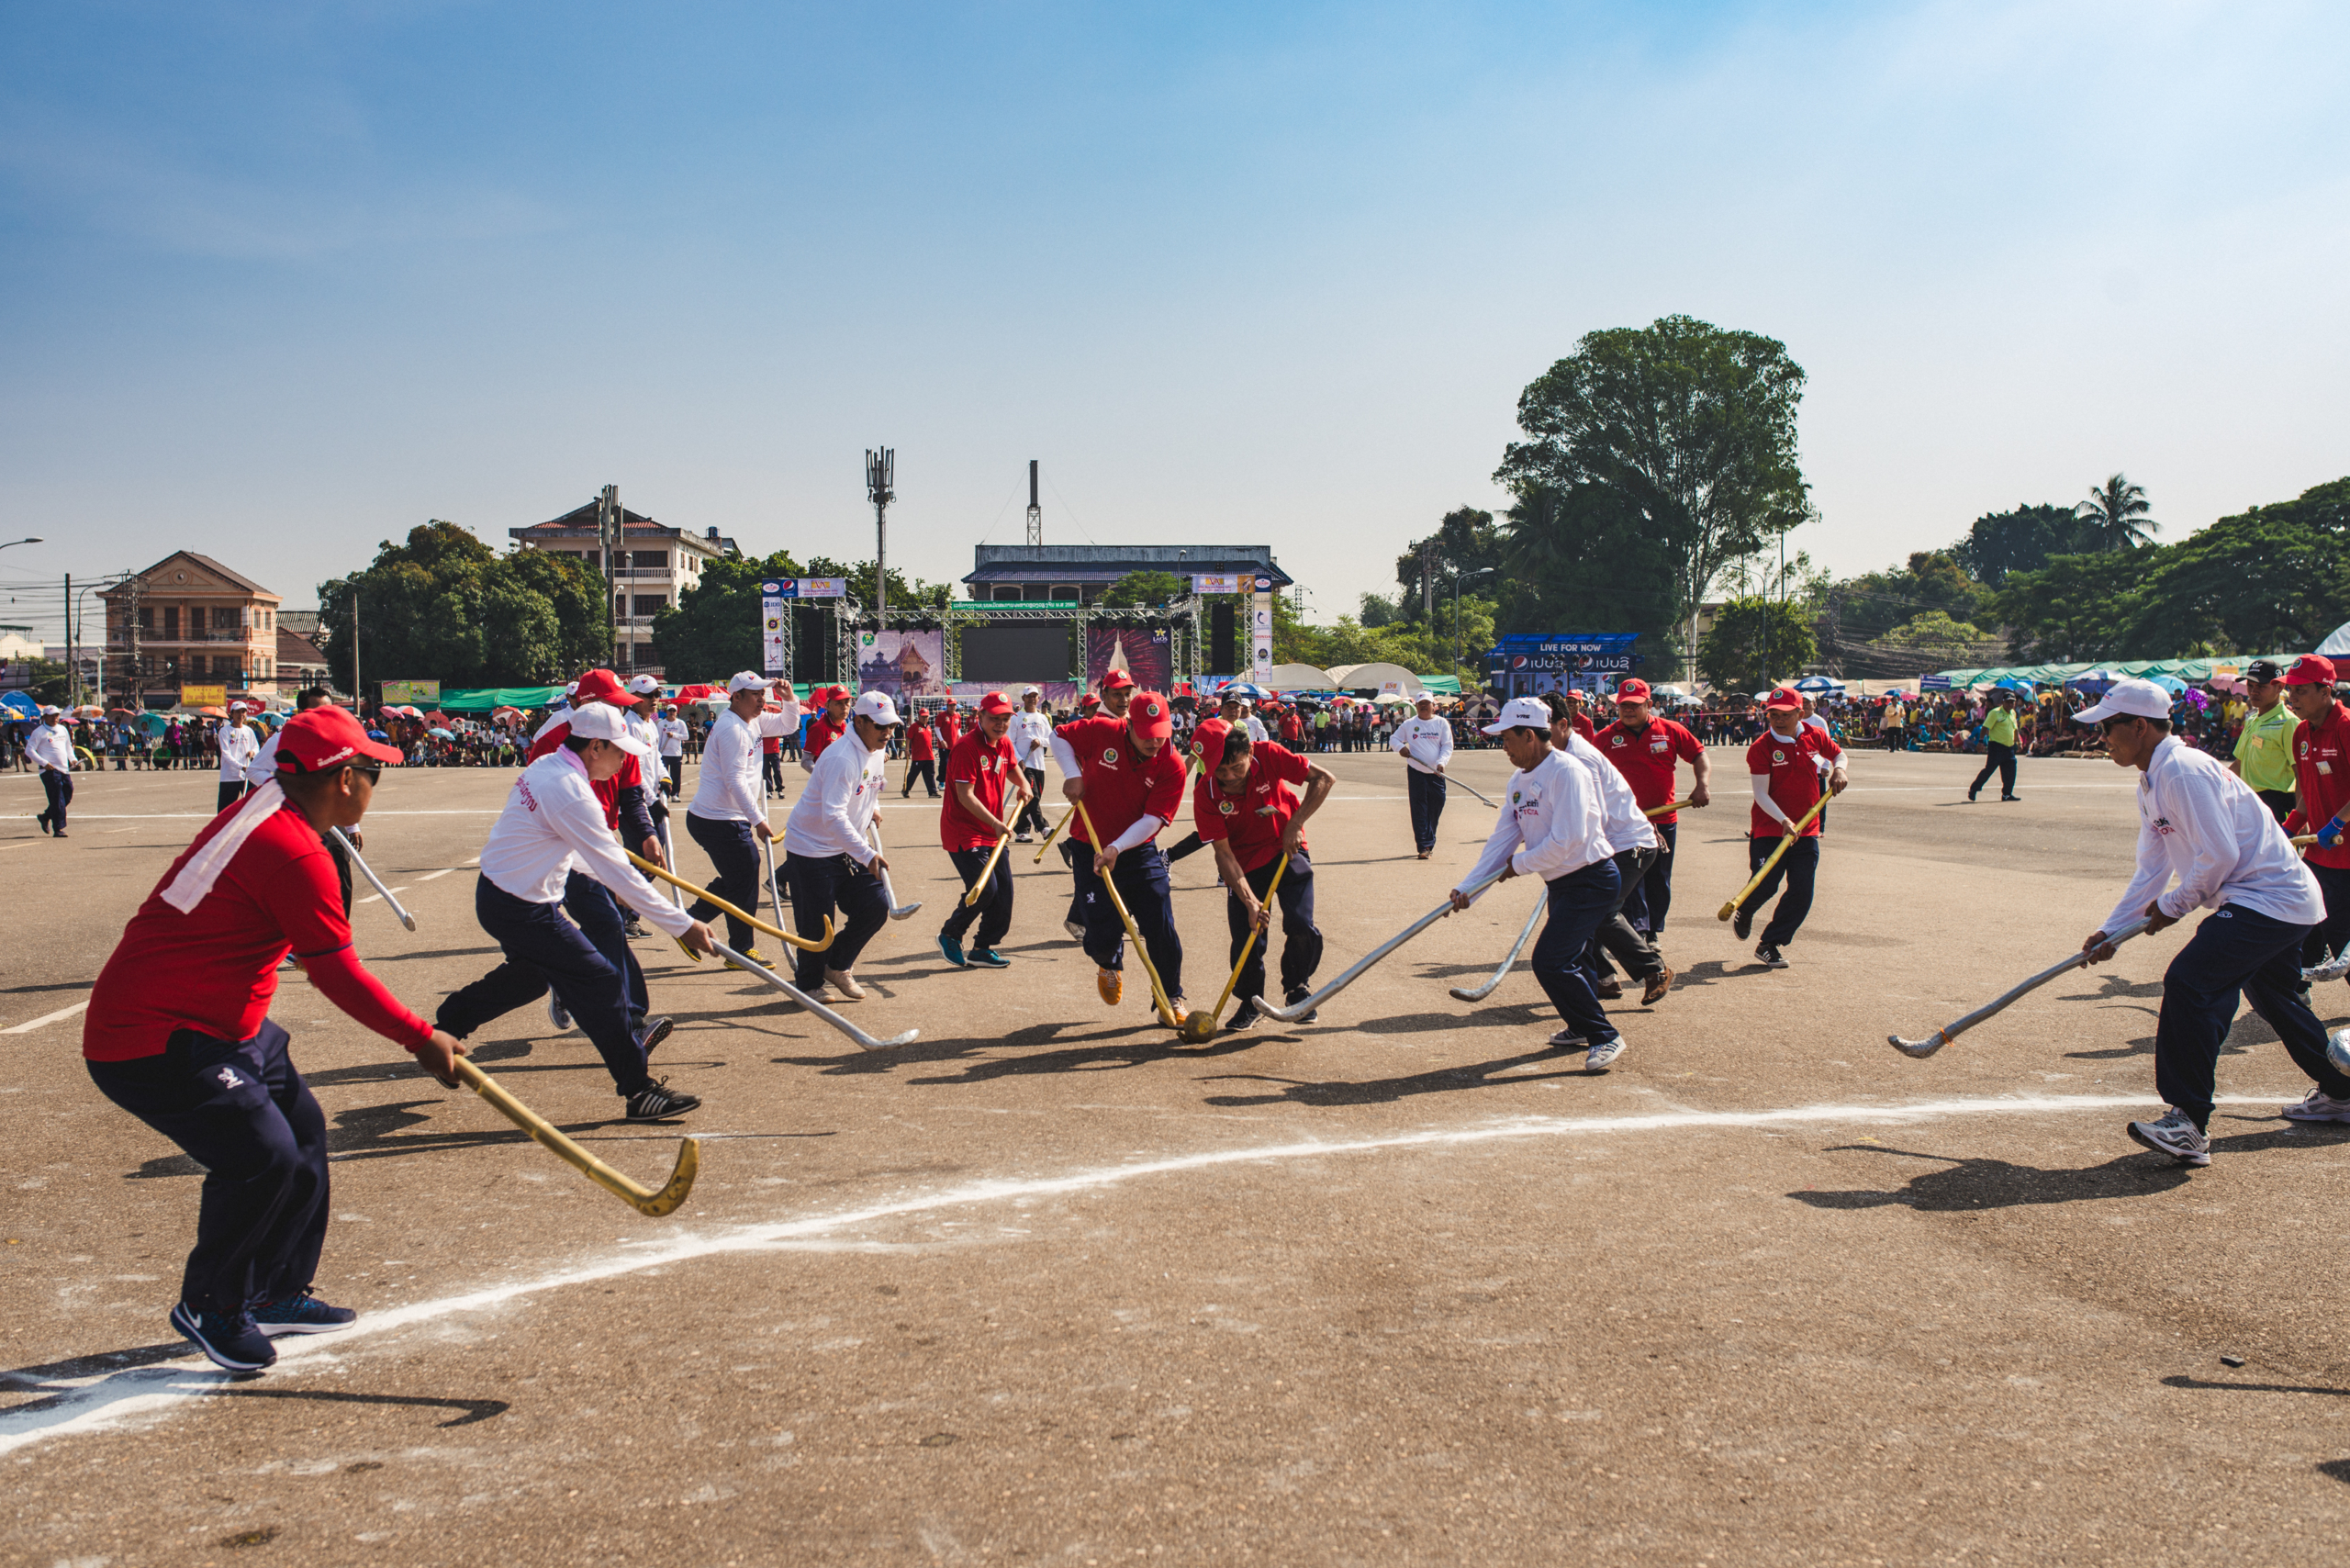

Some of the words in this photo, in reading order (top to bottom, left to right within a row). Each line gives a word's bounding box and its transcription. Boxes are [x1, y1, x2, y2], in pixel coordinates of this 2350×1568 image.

[1540, 644, 1558, 652] LIVE
[1561, 644, 1577, 652] FOR
[1581, 644, 1601, 652] NOW
